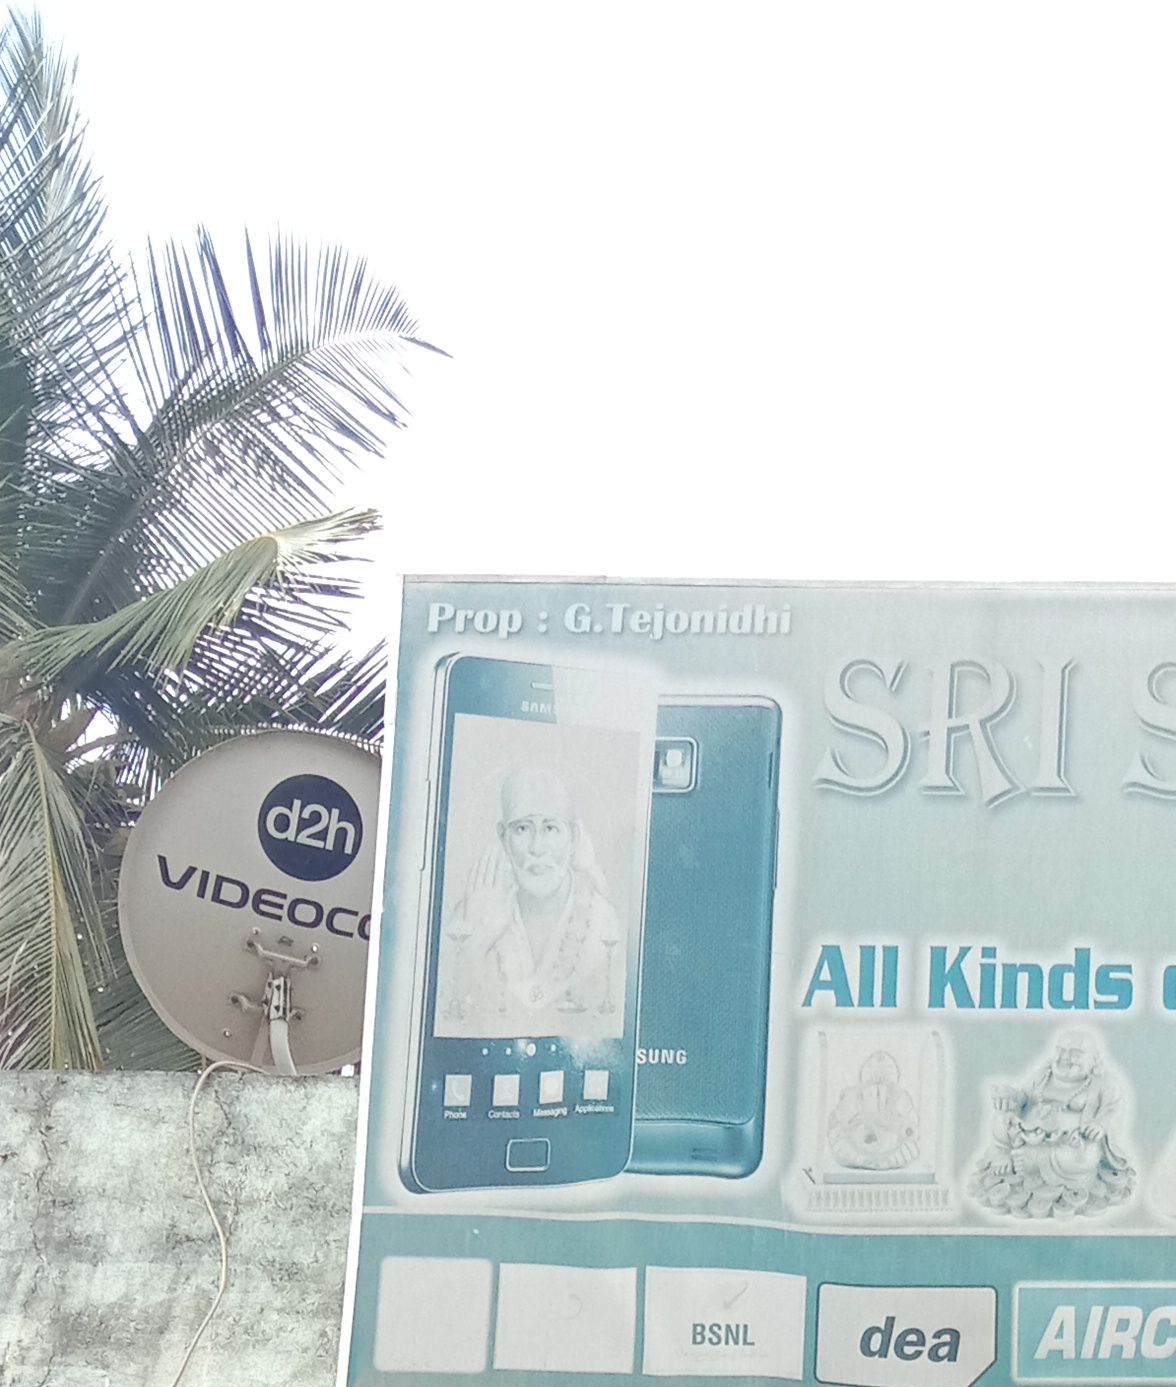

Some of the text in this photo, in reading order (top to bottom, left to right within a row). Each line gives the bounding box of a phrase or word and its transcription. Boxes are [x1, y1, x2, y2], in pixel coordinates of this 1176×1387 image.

[427, 602, 523, 640] Prop
[563, 602, 792, 640] G.Tejonidhi
[812, 656, 1079, 809] SRI
[265, 798, 357, 856] d2h
[801, 944, 899, 1010] All
[927, 945, 1134, 1011] Kinds
[488, 1109, 520, 1120] Contacts
[691, 1322, 755, 1347] BSNL
